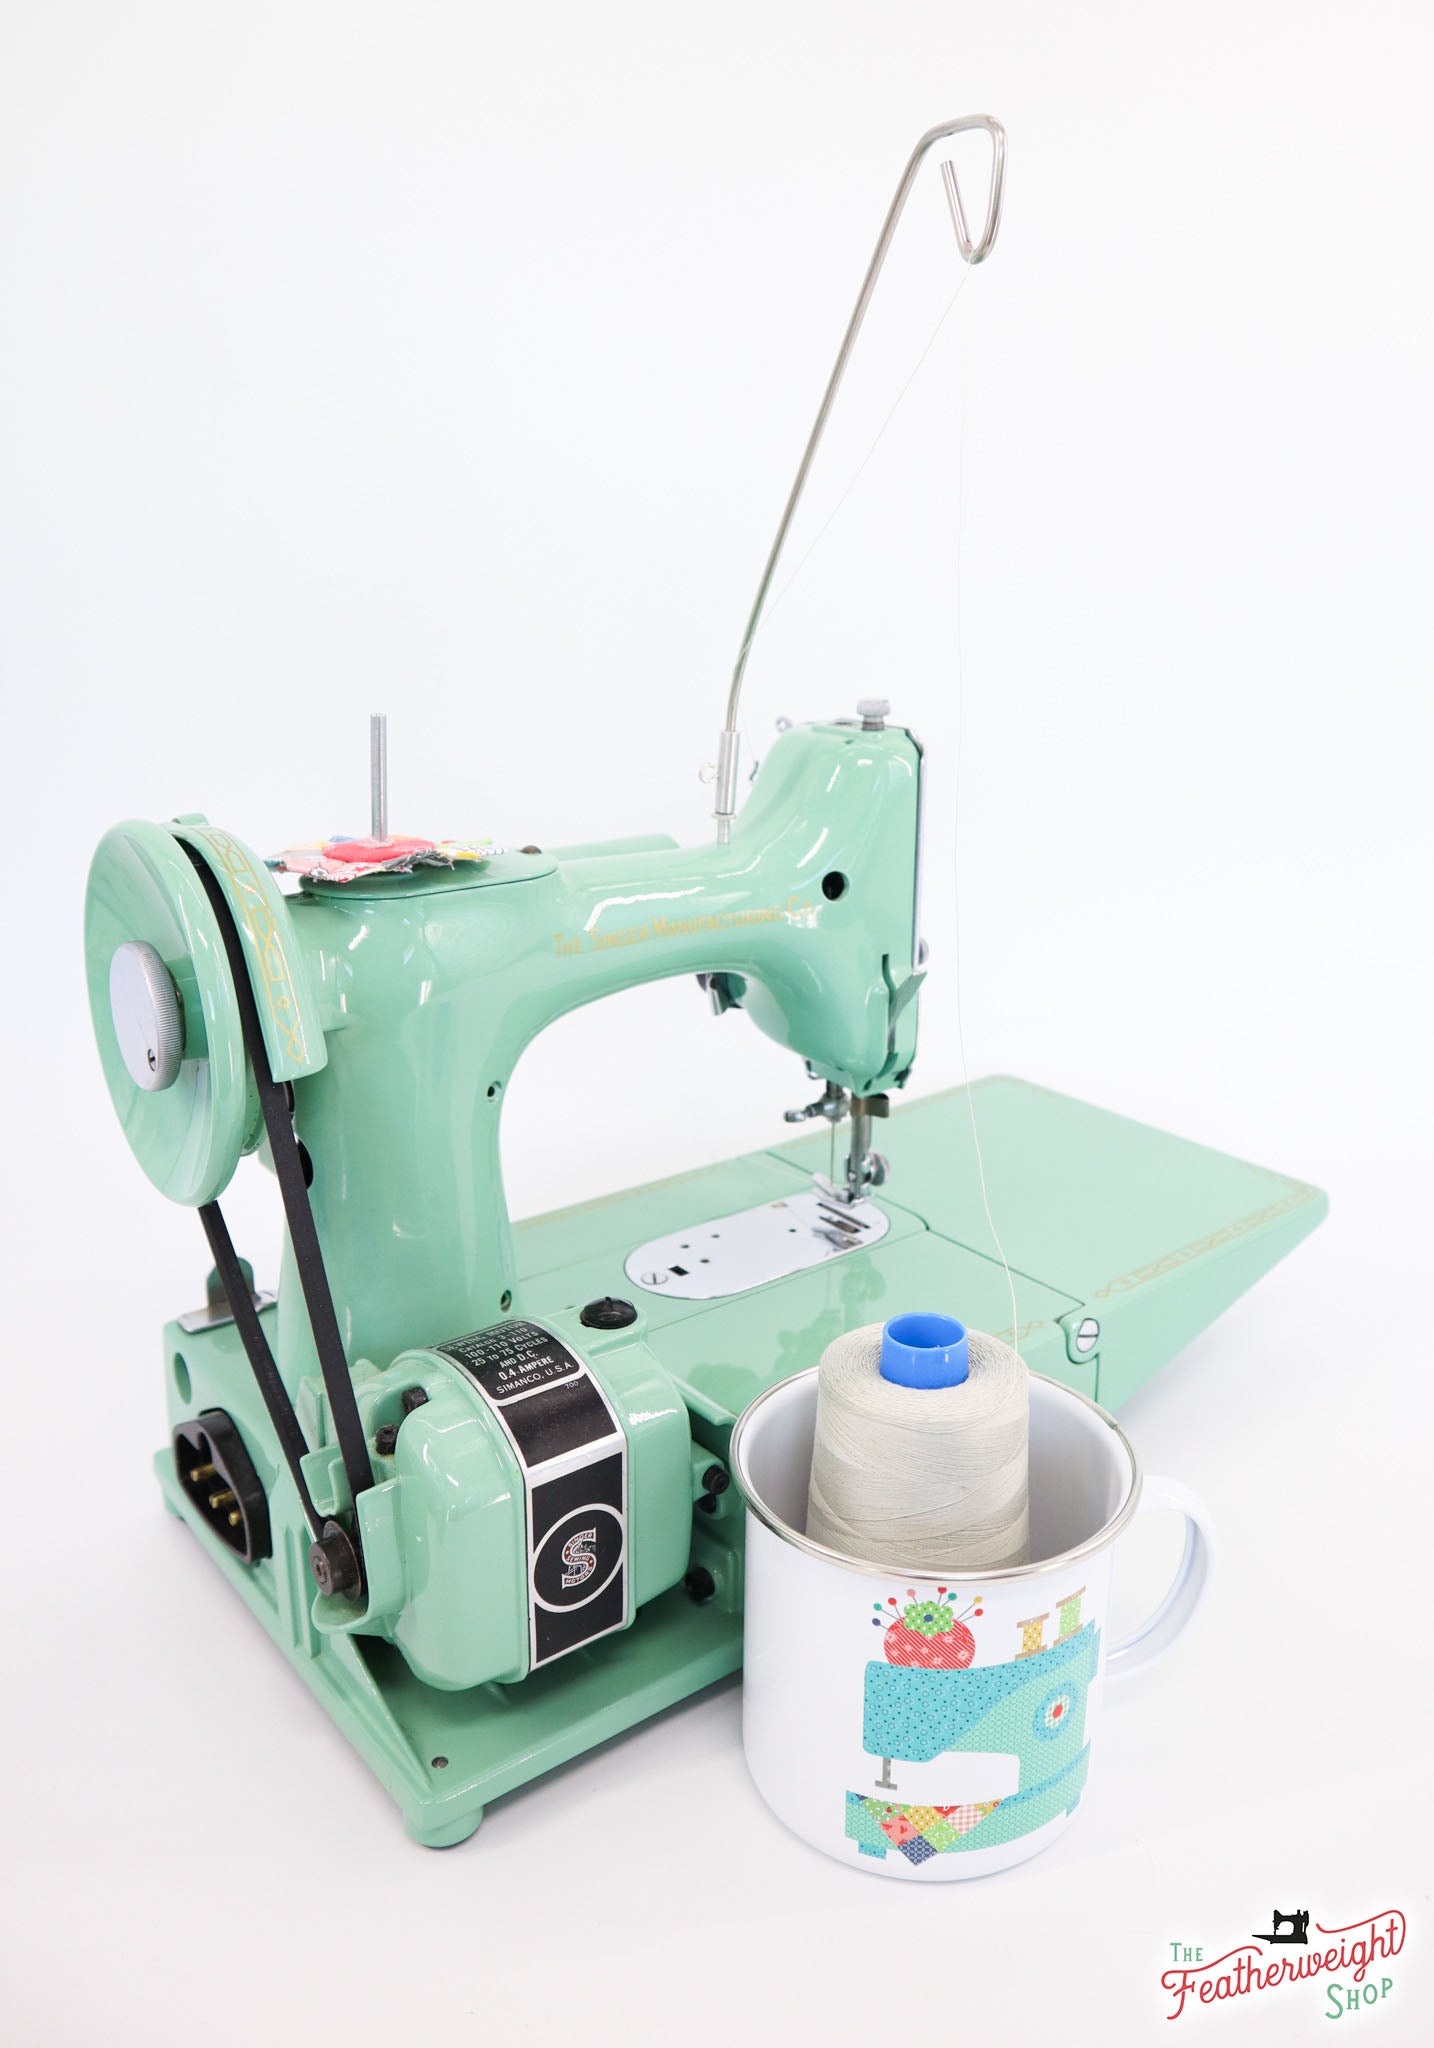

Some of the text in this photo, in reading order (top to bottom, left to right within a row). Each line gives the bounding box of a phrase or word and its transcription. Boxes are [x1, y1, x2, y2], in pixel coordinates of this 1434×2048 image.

[554, 932, 584, 958] THE
[588, 926, 650, 953] SINGER
[652, 905, 784, 940] MANUFACTURING
[441, 1321, 527, 1351] SEWING MOTOR
[464, 1331, 539, 1359] 100-110 VOLTS
[458, 1338, 497, 1353] CATALOG
[472, 1337, 549, 1367] 25 TO 75 CYCLES
[498, 1355, 555, 1381] 0.4 AMPERE
[499, 1350, 539, 1369] AND D.C.
[546, 1362, 574, 1379] U.S.A.
[565, 1381, 578, 1389] 700
[568, 1533, 593, 1546] SINGER
[566, 1554, 590, 1562] SEWING
[565, 1567, 593, 1583] MOTORS
